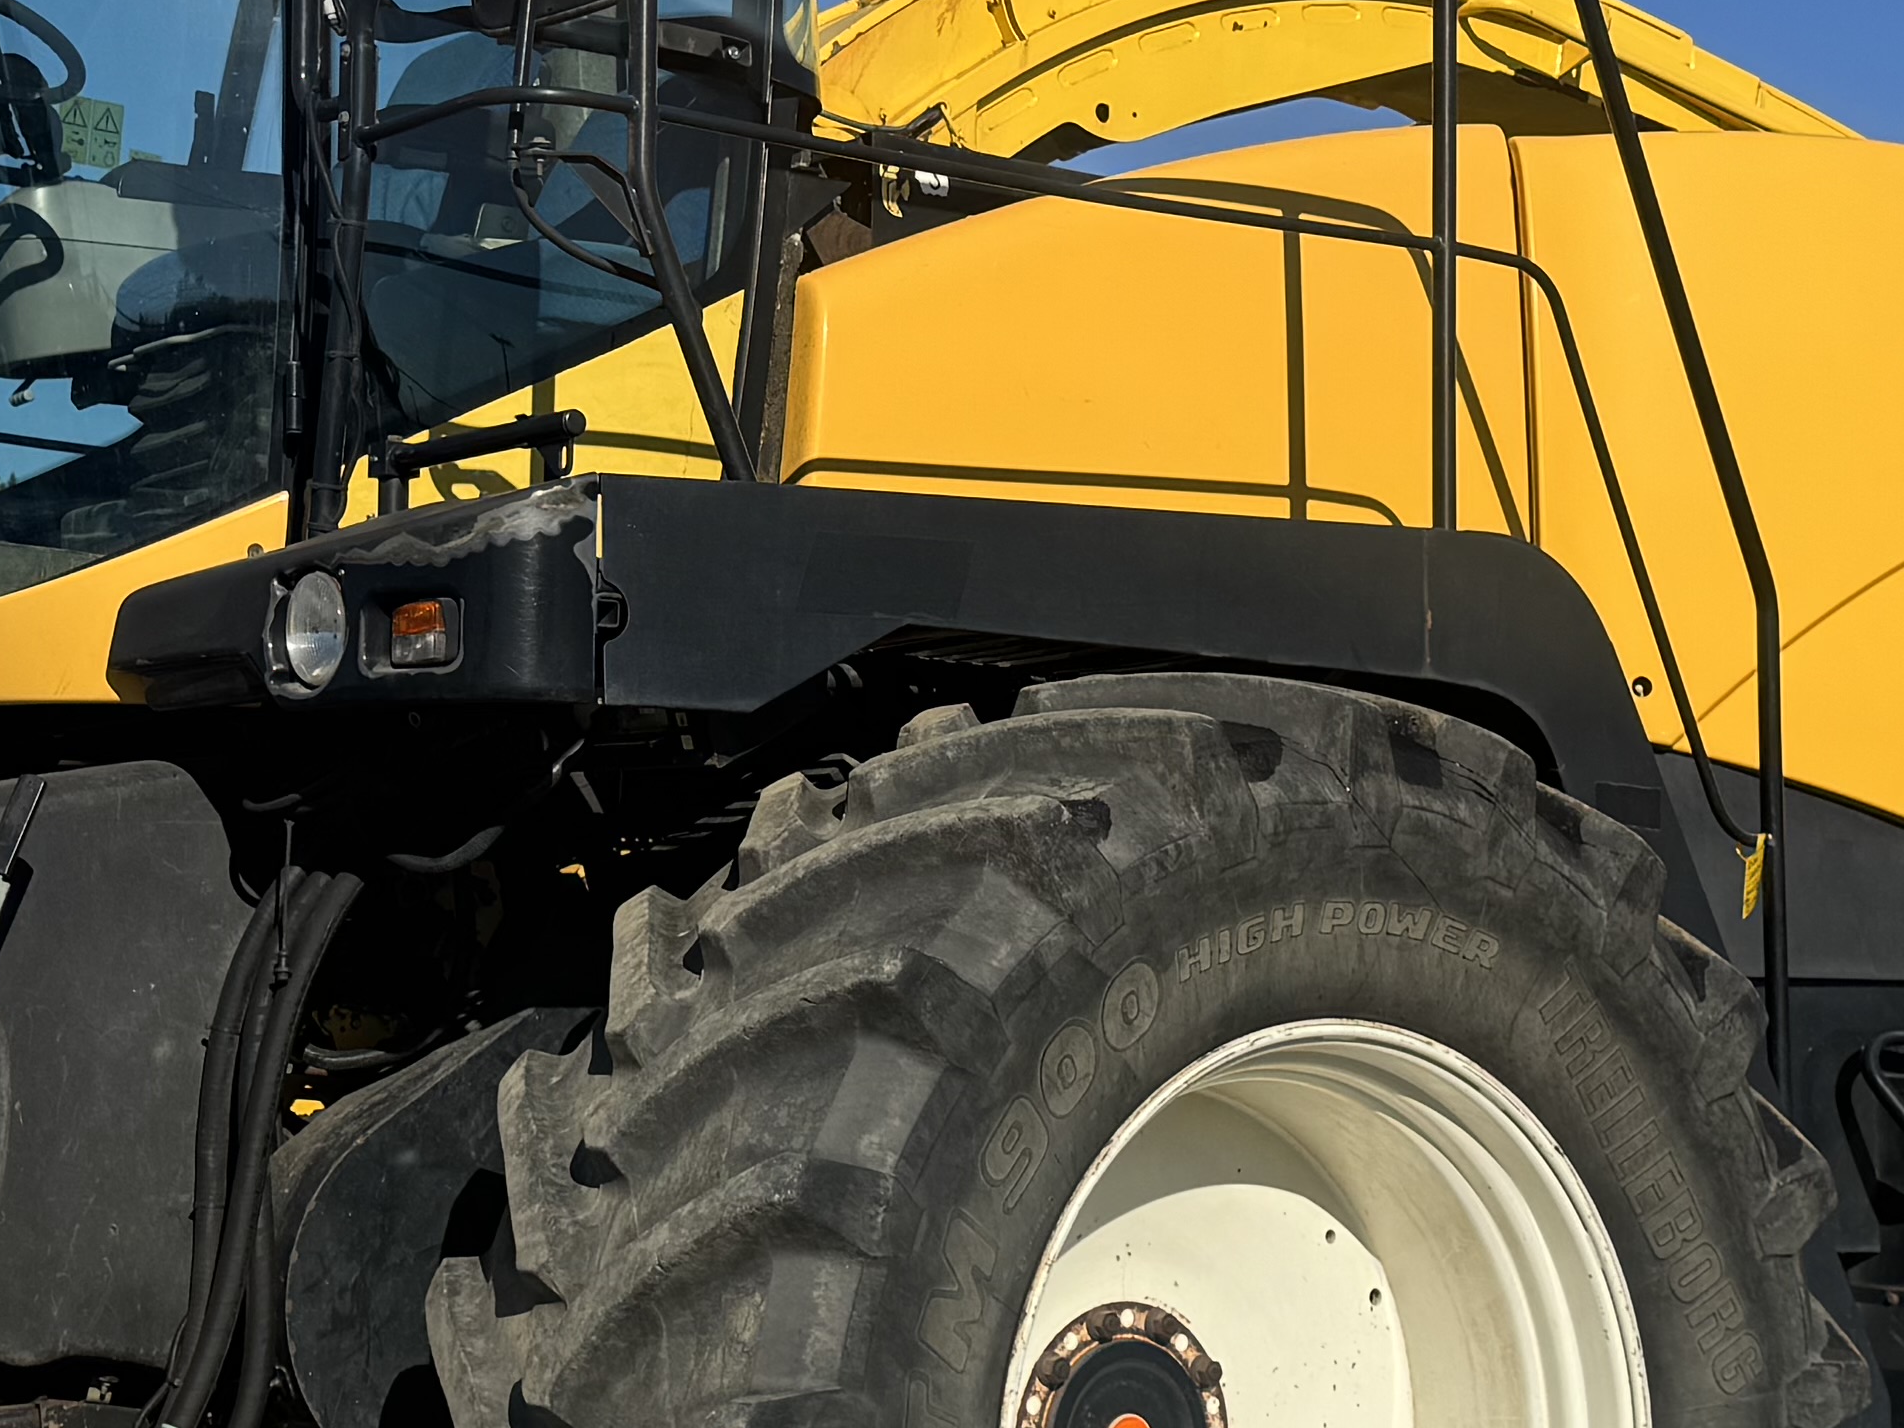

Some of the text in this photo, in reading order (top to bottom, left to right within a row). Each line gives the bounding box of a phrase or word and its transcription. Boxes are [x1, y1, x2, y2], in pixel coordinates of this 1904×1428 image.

[979, 955, 1161, 1215] 900
[1175, 900, 1306, 984] HIGH
[1318, 900, 1501, 971] POWER
[1537, 957, 1765, 1397] TRELLEBORG
